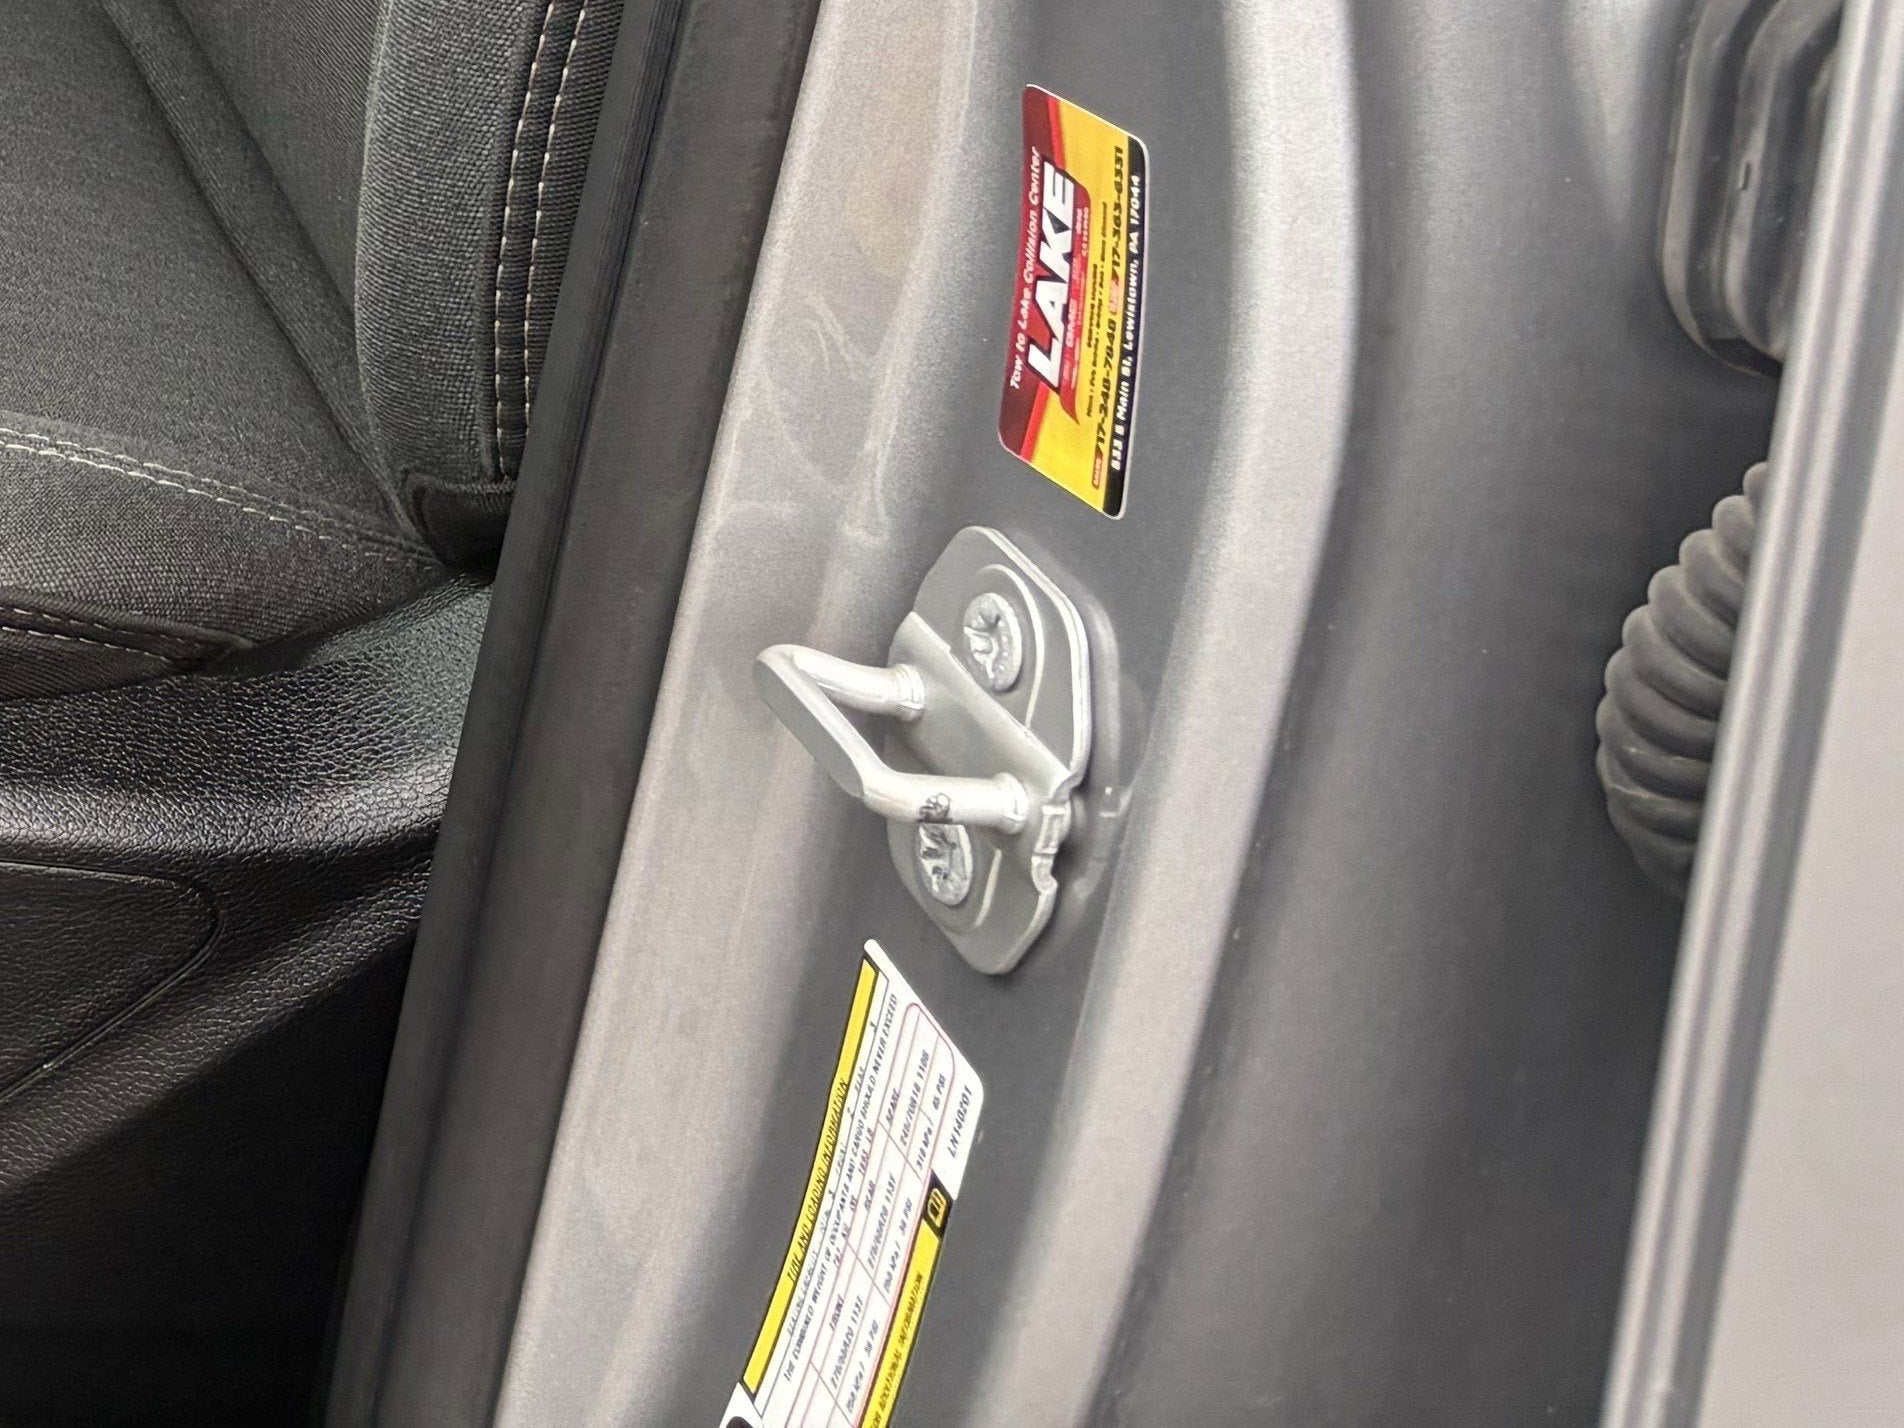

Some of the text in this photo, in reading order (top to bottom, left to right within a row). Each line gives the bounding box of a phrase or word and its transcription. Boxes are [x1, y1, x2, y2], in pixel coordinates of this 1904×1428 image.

[1129, 232, 1140, 254] PA
[1130, 175, 1141, 225] 17044
[1010, 146, 1043, 390] Tow to Lake Collision Center
[1028, 160, 1075, 389] LAKE
[1116, 381, 1130, 421] Main
[796, 1221, 810, 1254] AND
[818, 1075, 851, 1169] INFORMATION
